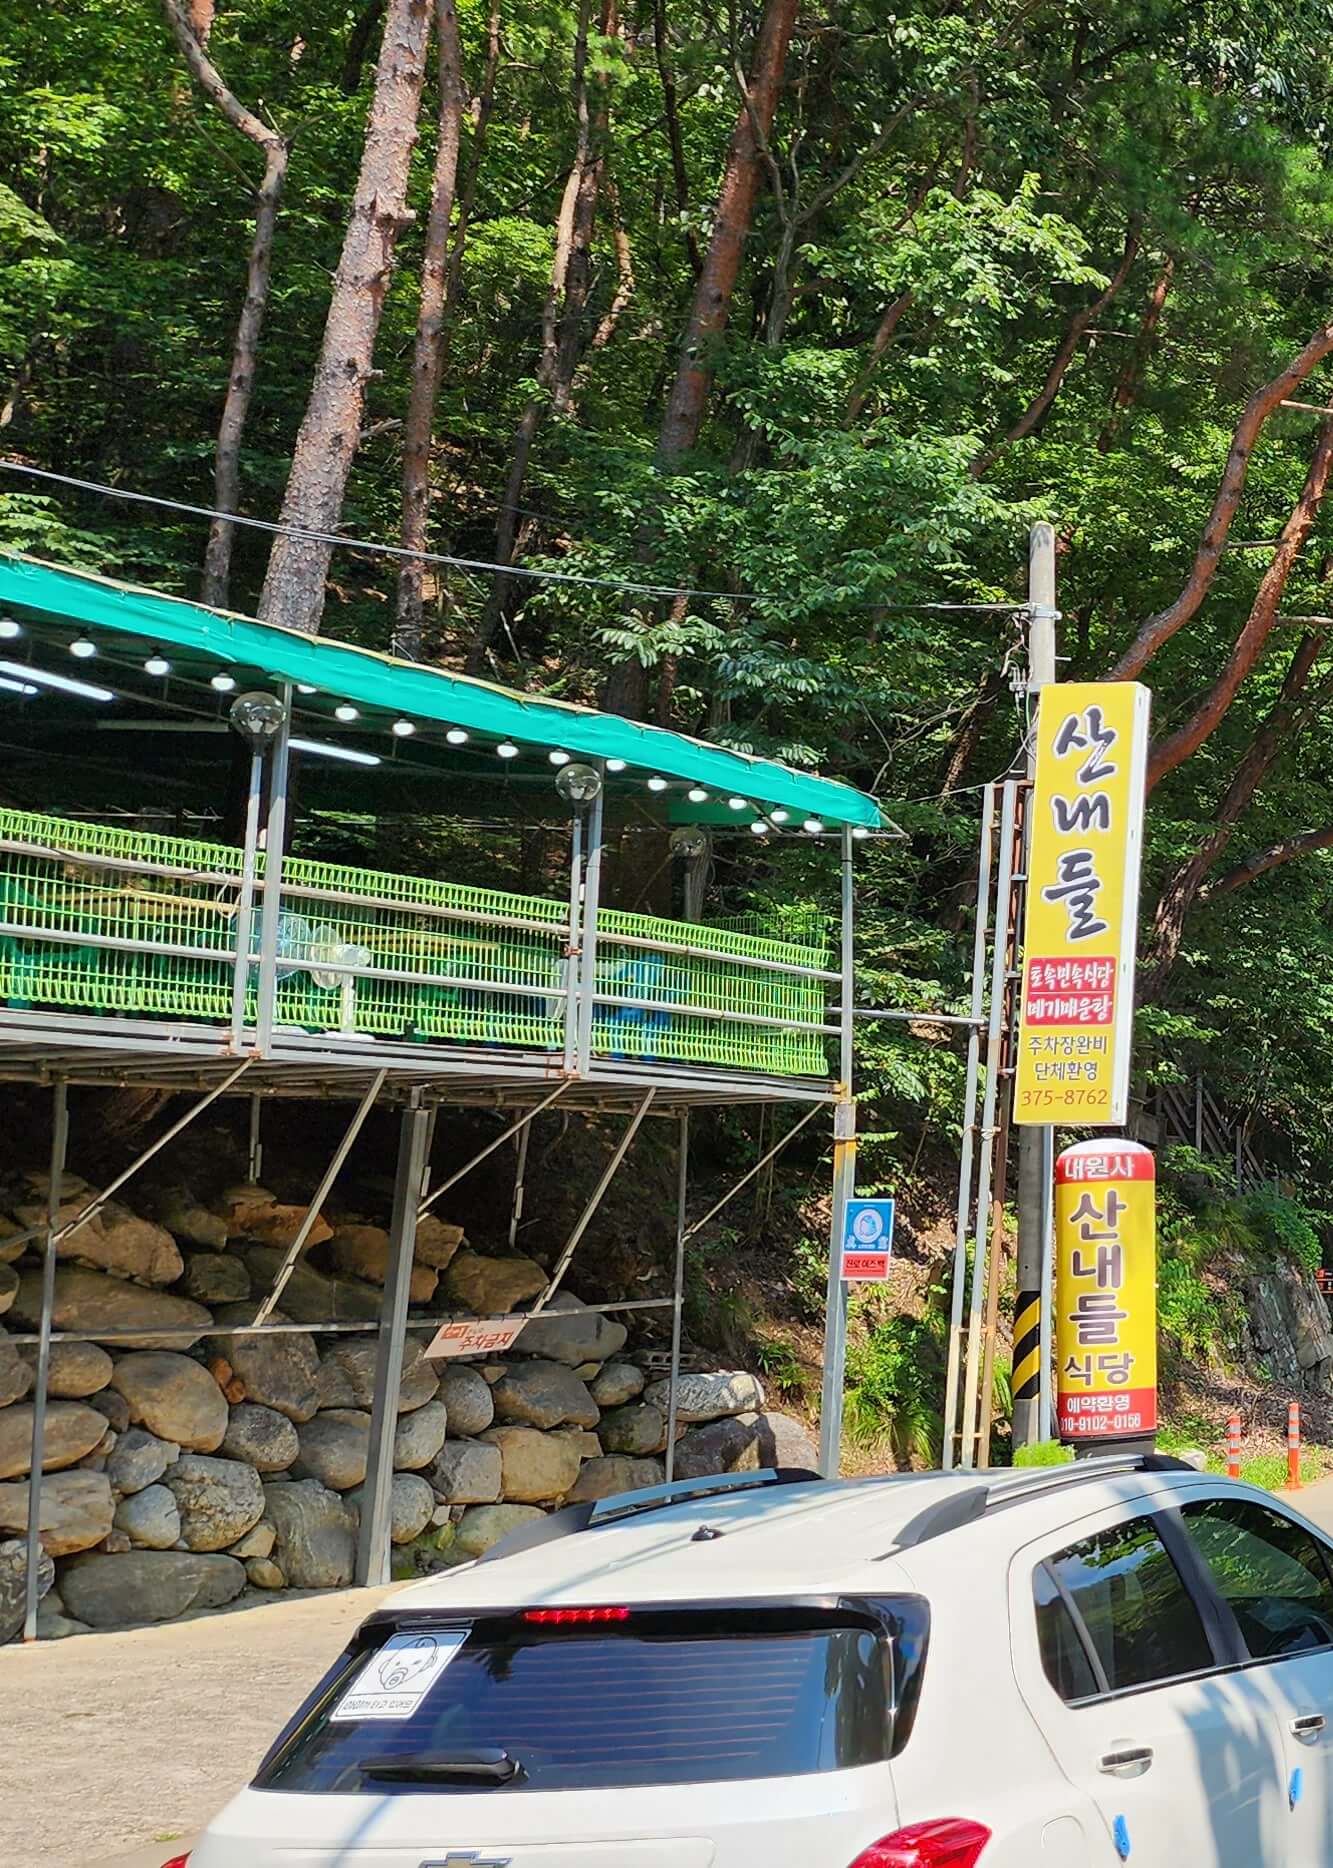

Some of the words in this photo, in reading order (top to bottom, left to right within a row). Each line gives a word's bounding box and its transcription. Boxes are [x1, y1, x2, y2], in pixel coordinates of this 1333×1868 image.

[1043, 706, 1117, 940] 산내들
[1030, 961, 1114, 989] 토속민속식당
[1027, 995, 1112, 1021] 메기매운탕
[1028, 1035, 1107, 1056] 주차장완비
[1035, 1061, 1098, 1081] 단체환영
[1021, 1089, 1108, 1106] 375-8762
[1064, 1156, 1135, 1179] 내원사
[1069, 1189, 1127, 1345] 산내들
[459, 1331, 514, 1351] 주차금지
[1064, 1352, 1134, 1387] 식당
[1067, 1394, 1130, 1413] 예약환영
